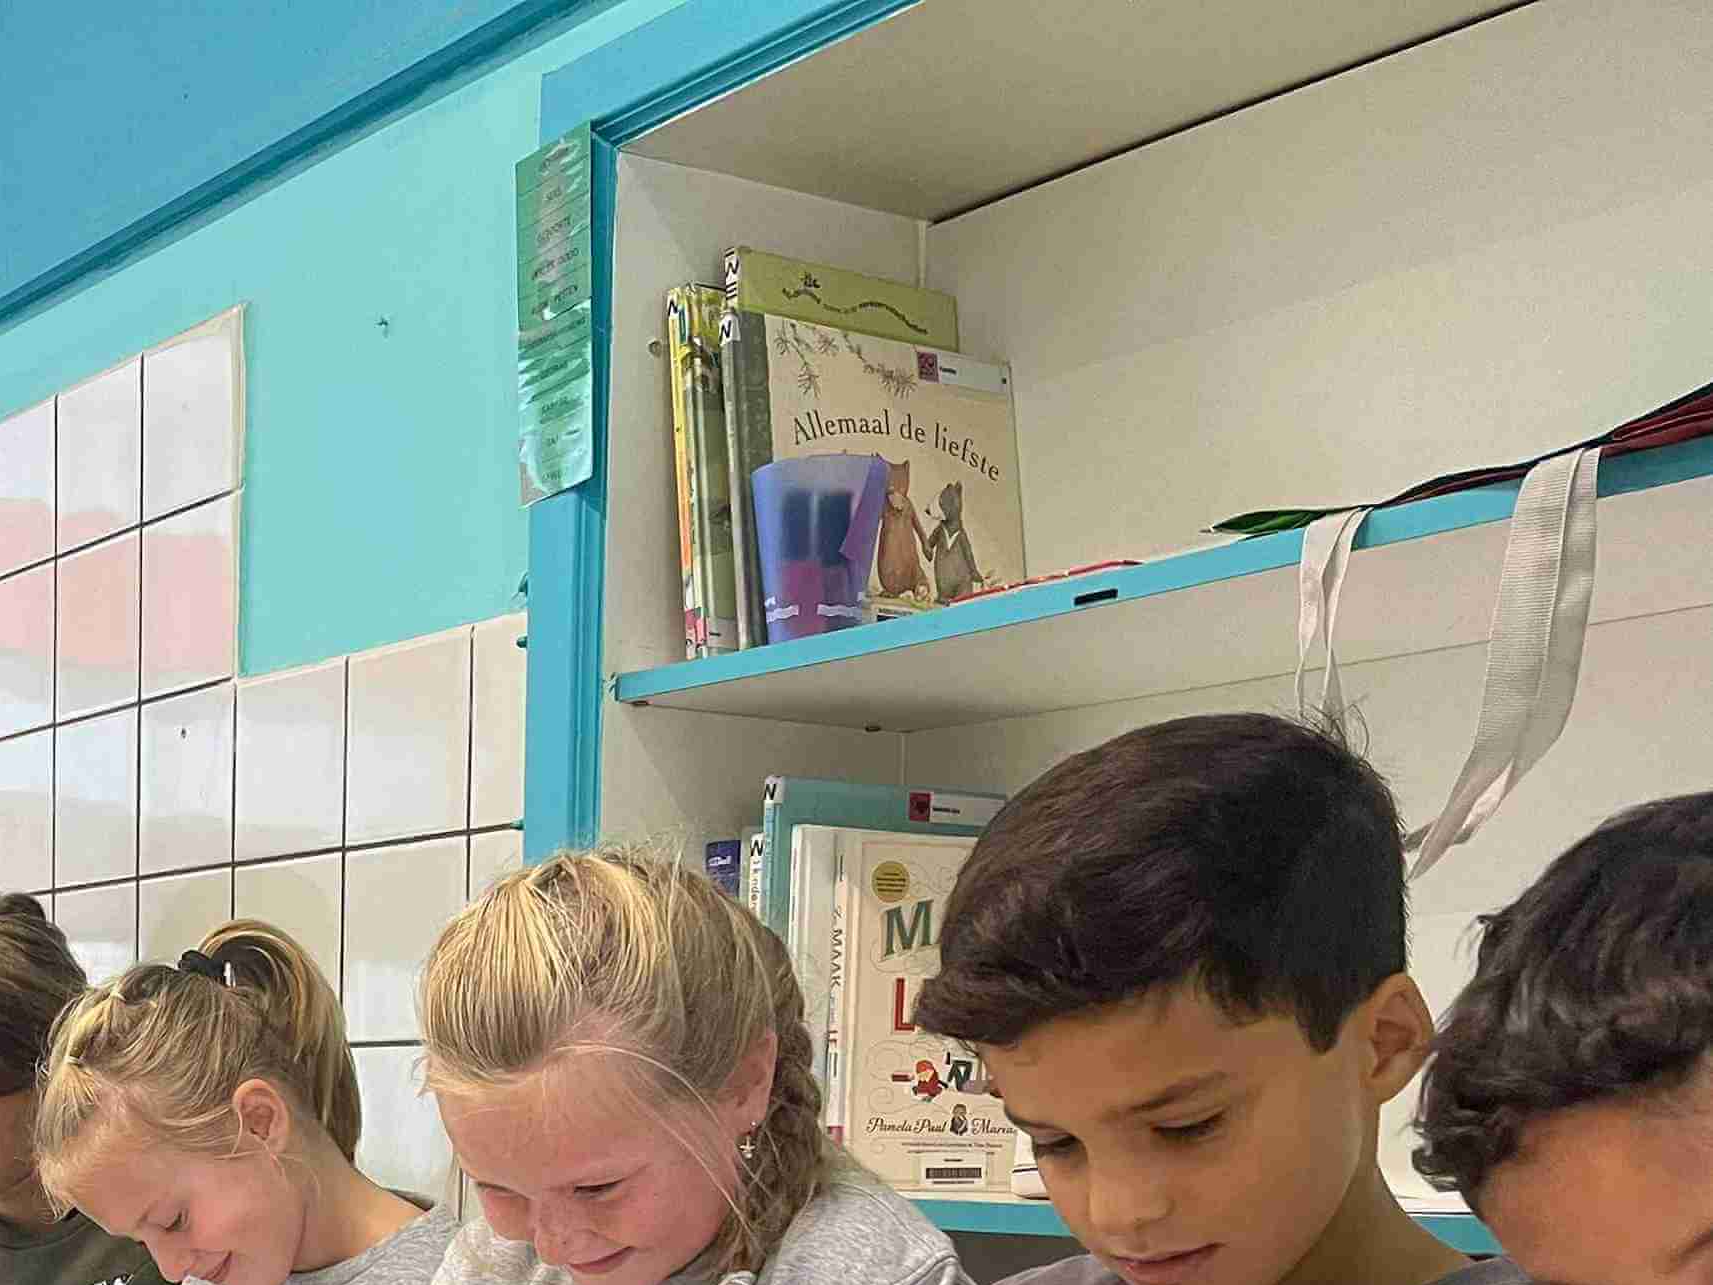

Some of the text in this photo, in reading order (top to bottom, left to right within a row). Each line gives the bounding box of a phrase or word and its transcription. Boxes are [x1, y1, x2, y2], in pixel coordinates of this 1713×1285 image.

[793, 408, 1000, 482] Allemaal de liefste
[913, 1117, 947, 1135] Paul
